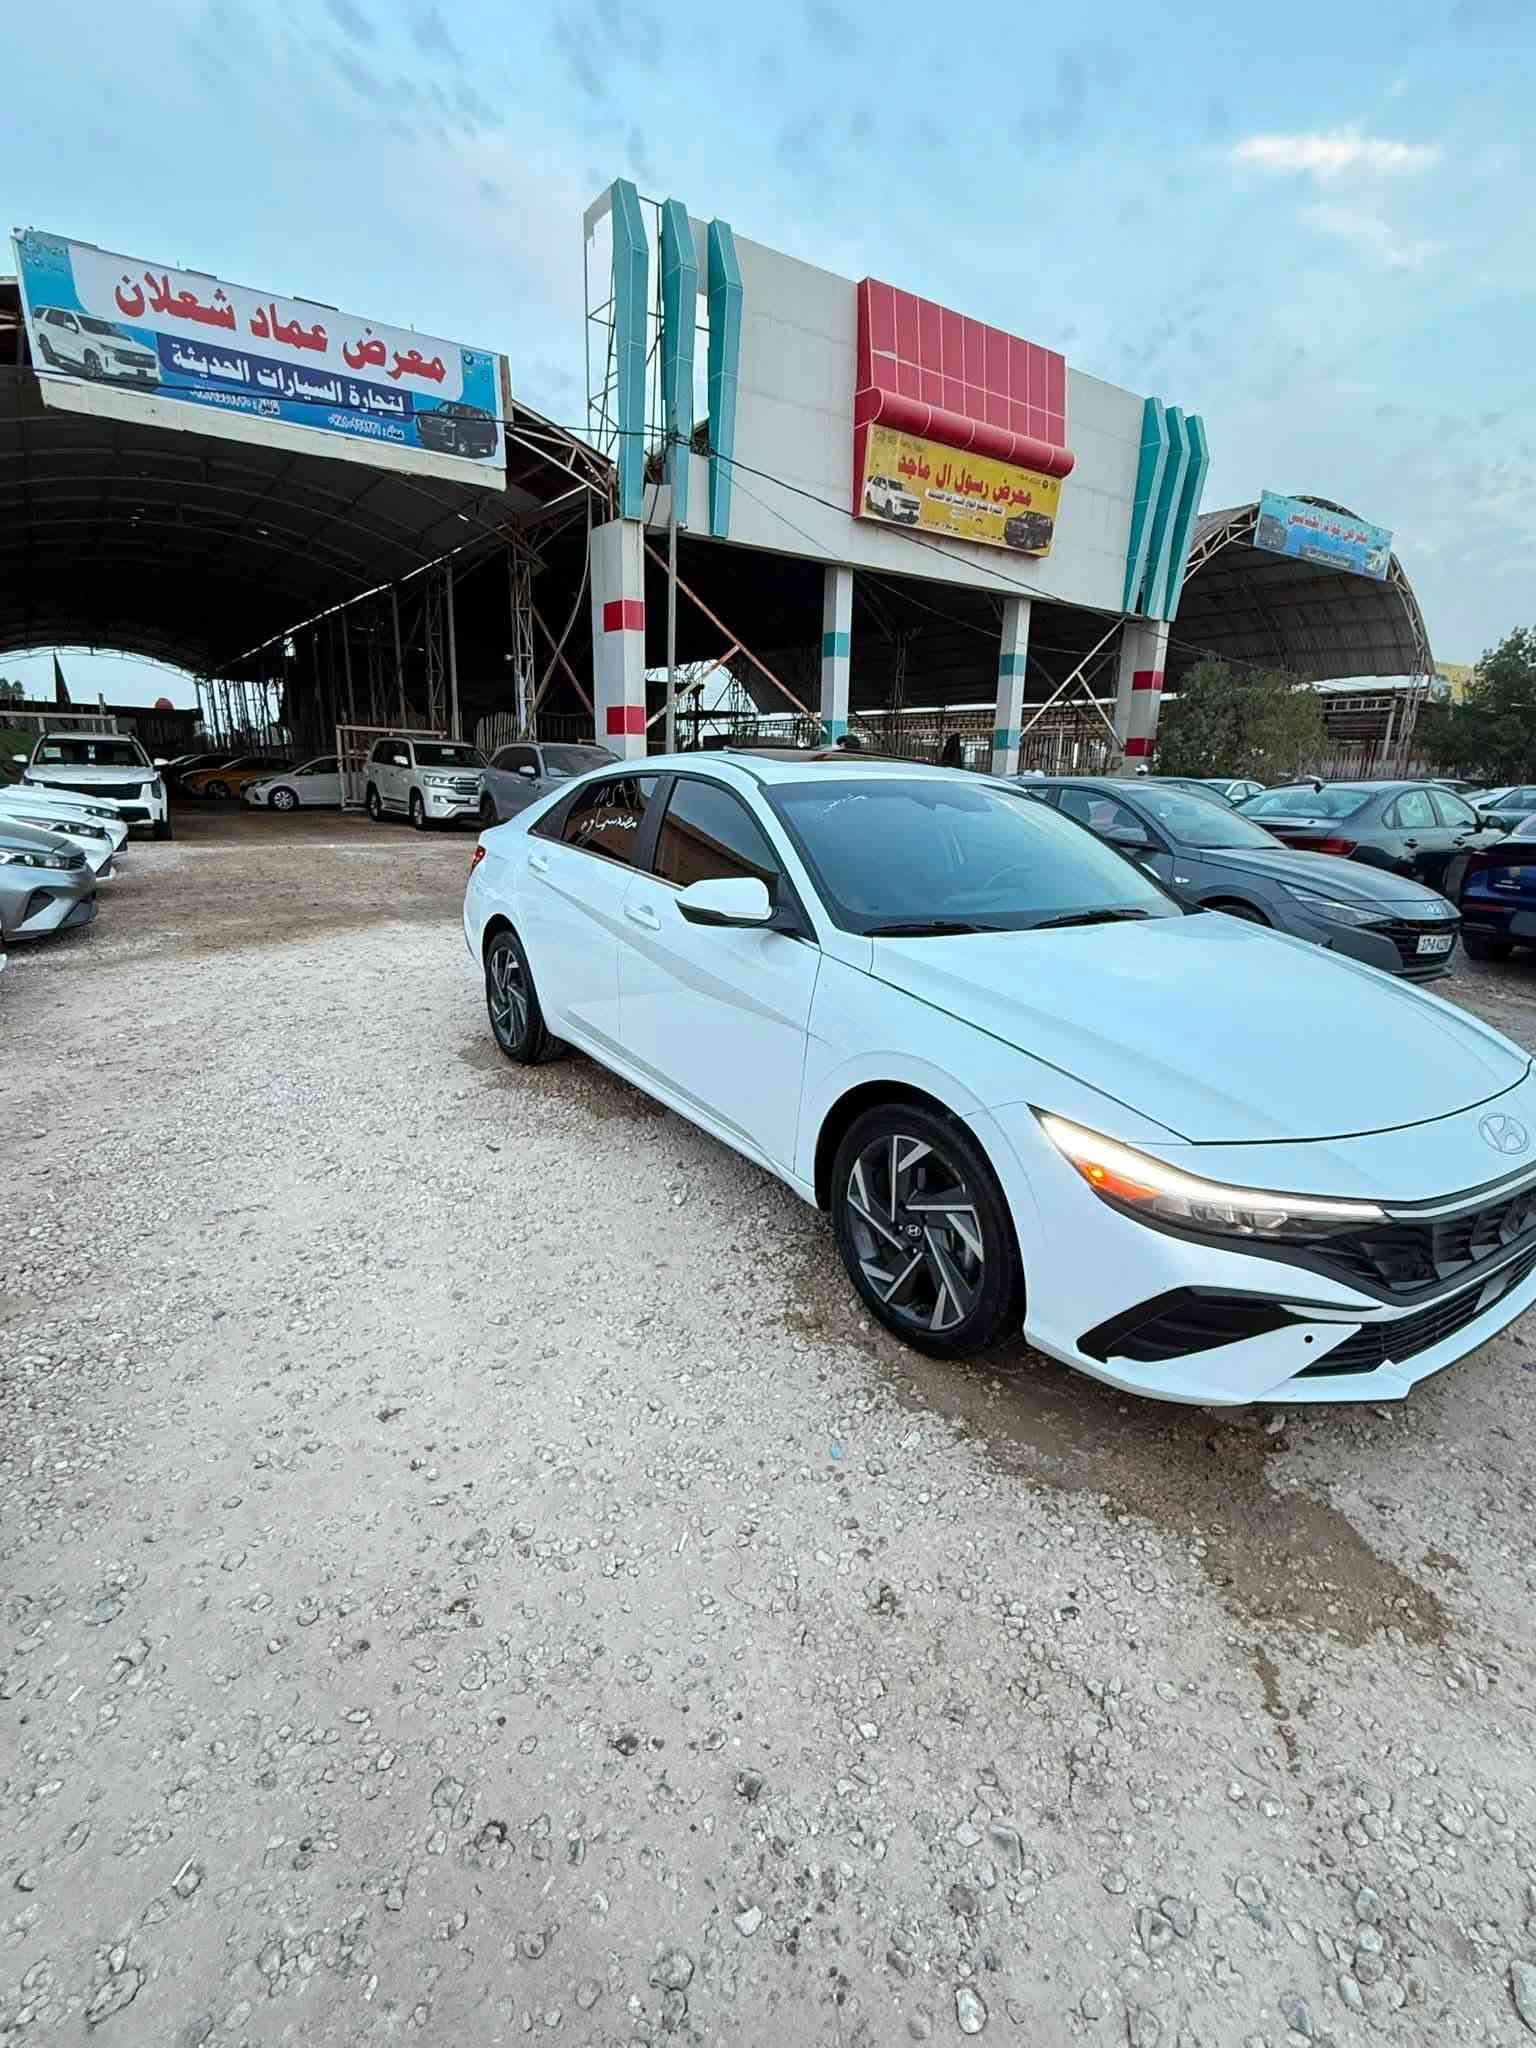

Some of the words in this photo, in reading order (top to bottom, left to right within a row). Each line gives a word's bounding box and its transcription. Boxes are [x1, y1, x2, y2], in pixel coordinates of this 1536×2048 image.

[114, 270, 238, 332] شعلان
[250, 303, 329, 353] عماد
[171, 343, 250, 383] الحديثة
[343, 327, 447, 385] معرض
[256, 366, 343, 402] السيارات
[349, 384, 405, 416] لتجارة
[897, 454, 931, 482] ماجد
[954, 467, 988, 500] رسول
[992, 477, 1032, 507] معرض
